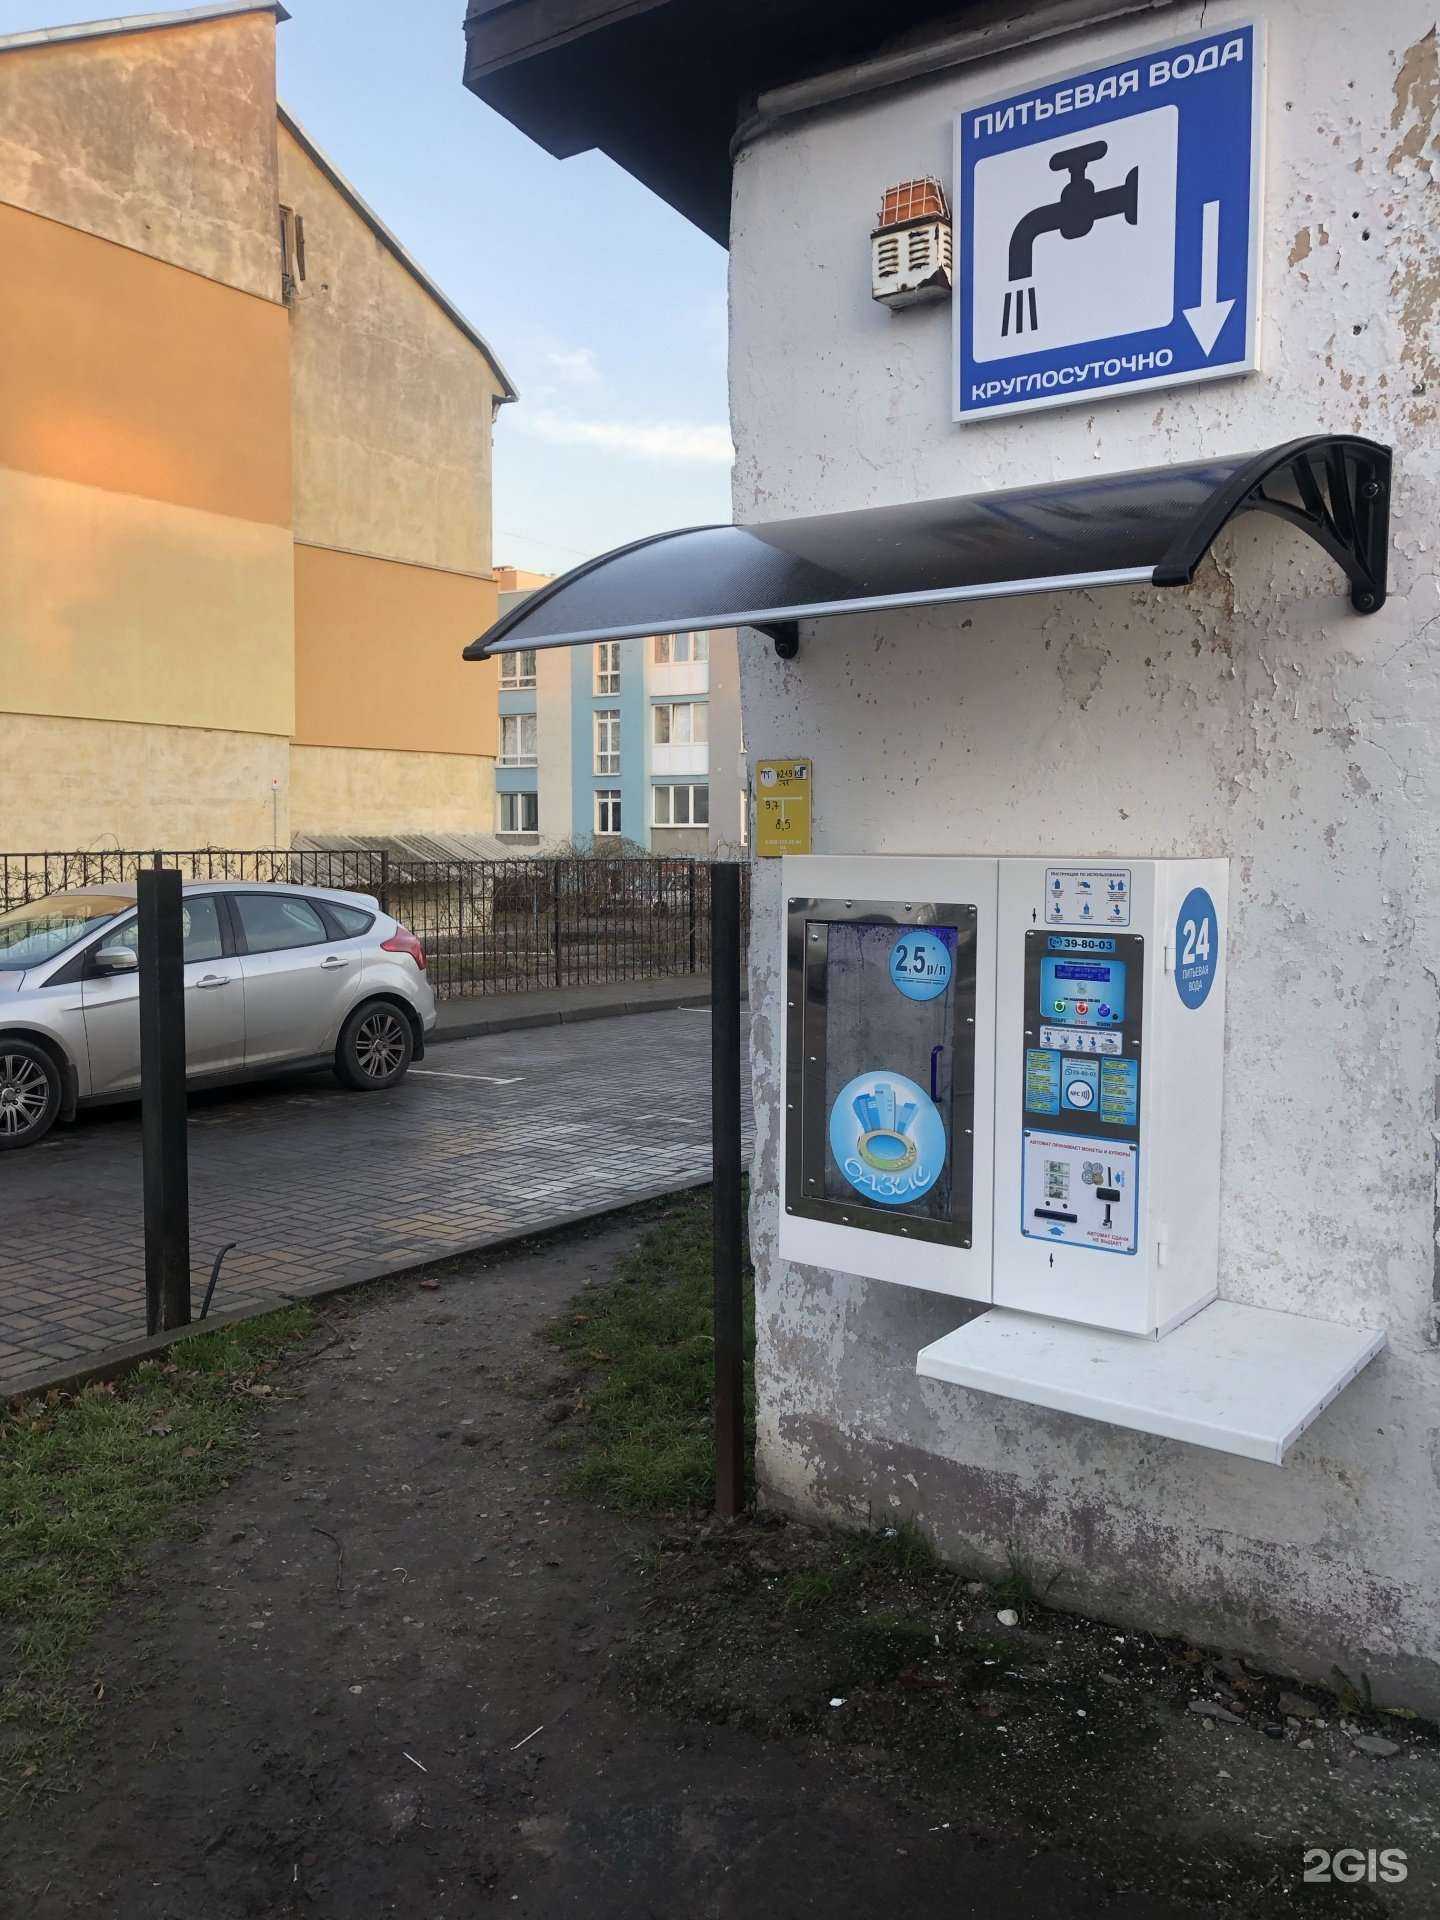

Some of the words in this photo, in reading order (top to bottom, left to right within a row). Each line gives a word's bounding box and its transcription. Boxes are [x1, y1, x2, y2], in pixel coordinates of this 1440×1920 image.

[973, 69, 1138, 139] ПИТЬЕВАЯ
[1149, 37, 1244, 88] ВОДА
[971, 348, 1174, 401] КРУГЛОСУТОЧНО
[895, 944, 926, 976] 2,5
[1064, 938, 1113, 950] 39-80-03
[1182, 917, 1210, 965] 24
